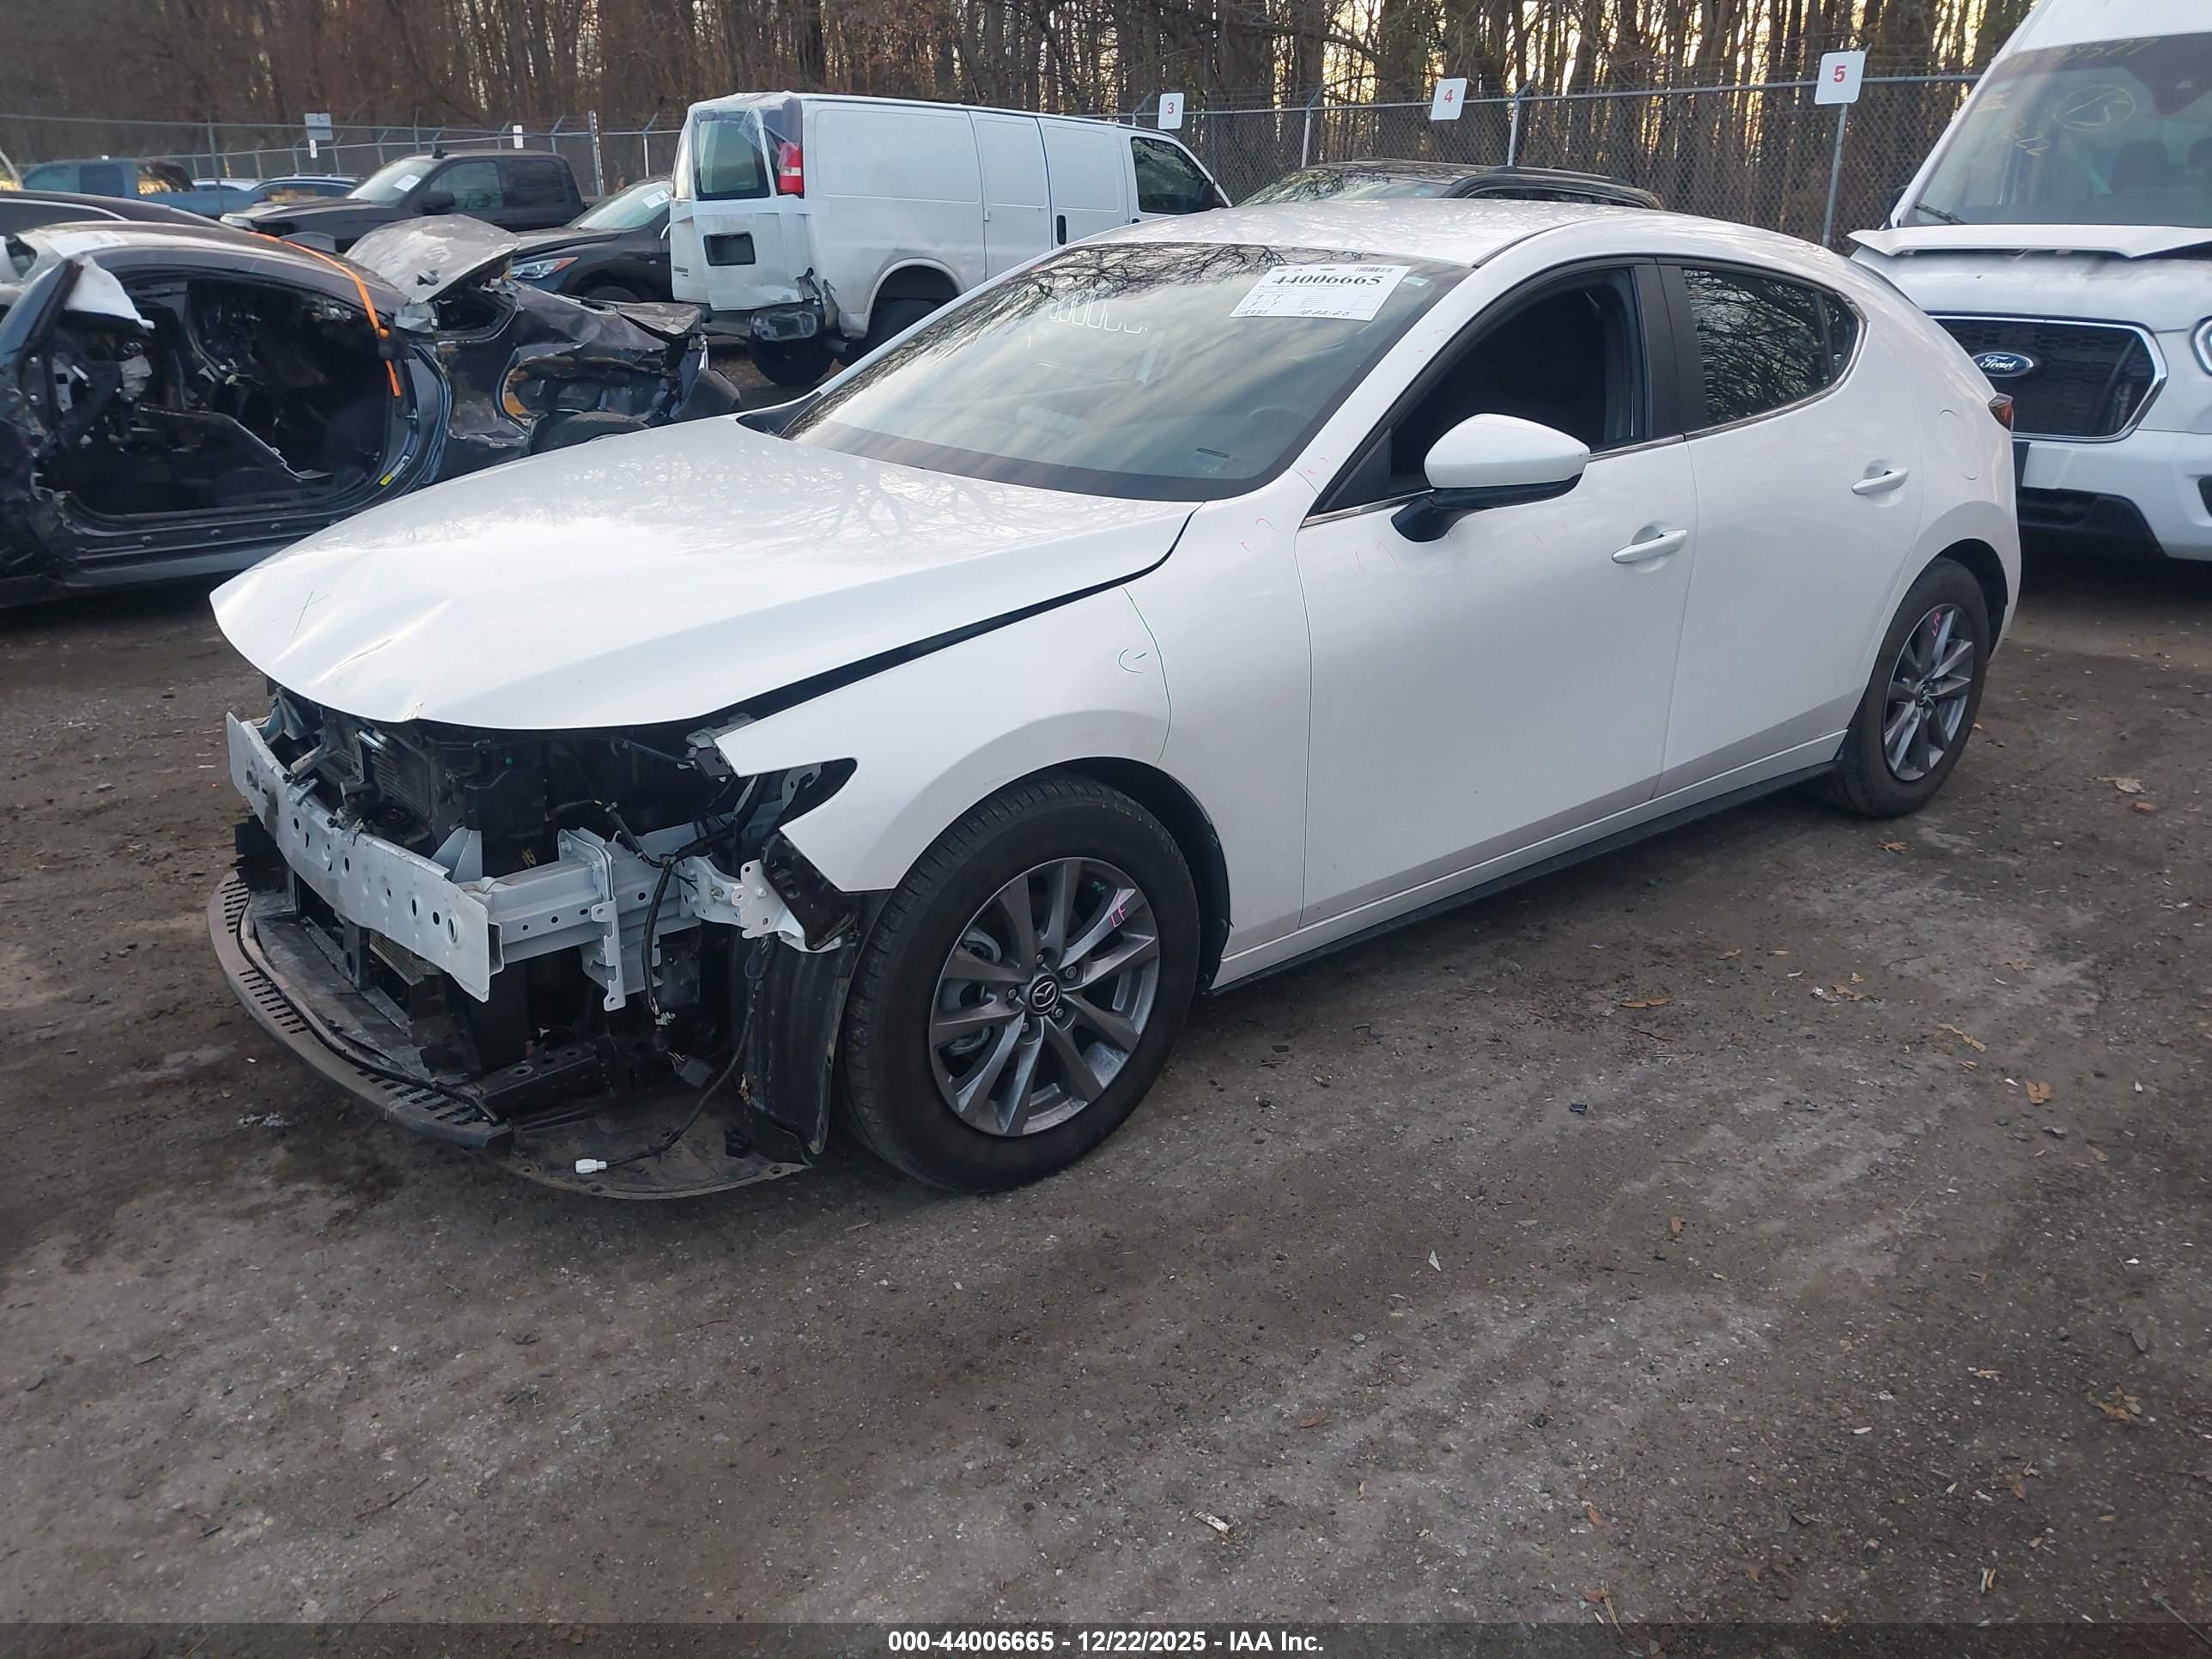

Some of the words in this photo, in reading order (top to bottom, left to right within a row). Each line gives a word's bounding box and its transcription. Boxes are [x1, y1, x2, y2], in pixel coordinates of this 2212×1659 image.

[1833, 64, 1846, 82] 5
[1443, 88, 1453, 103] 4
[1167, 102, 1175, 114] 3
[1271, 275, 1385, 286] 44006665
[1979, 355, 2017, 370] Ford
